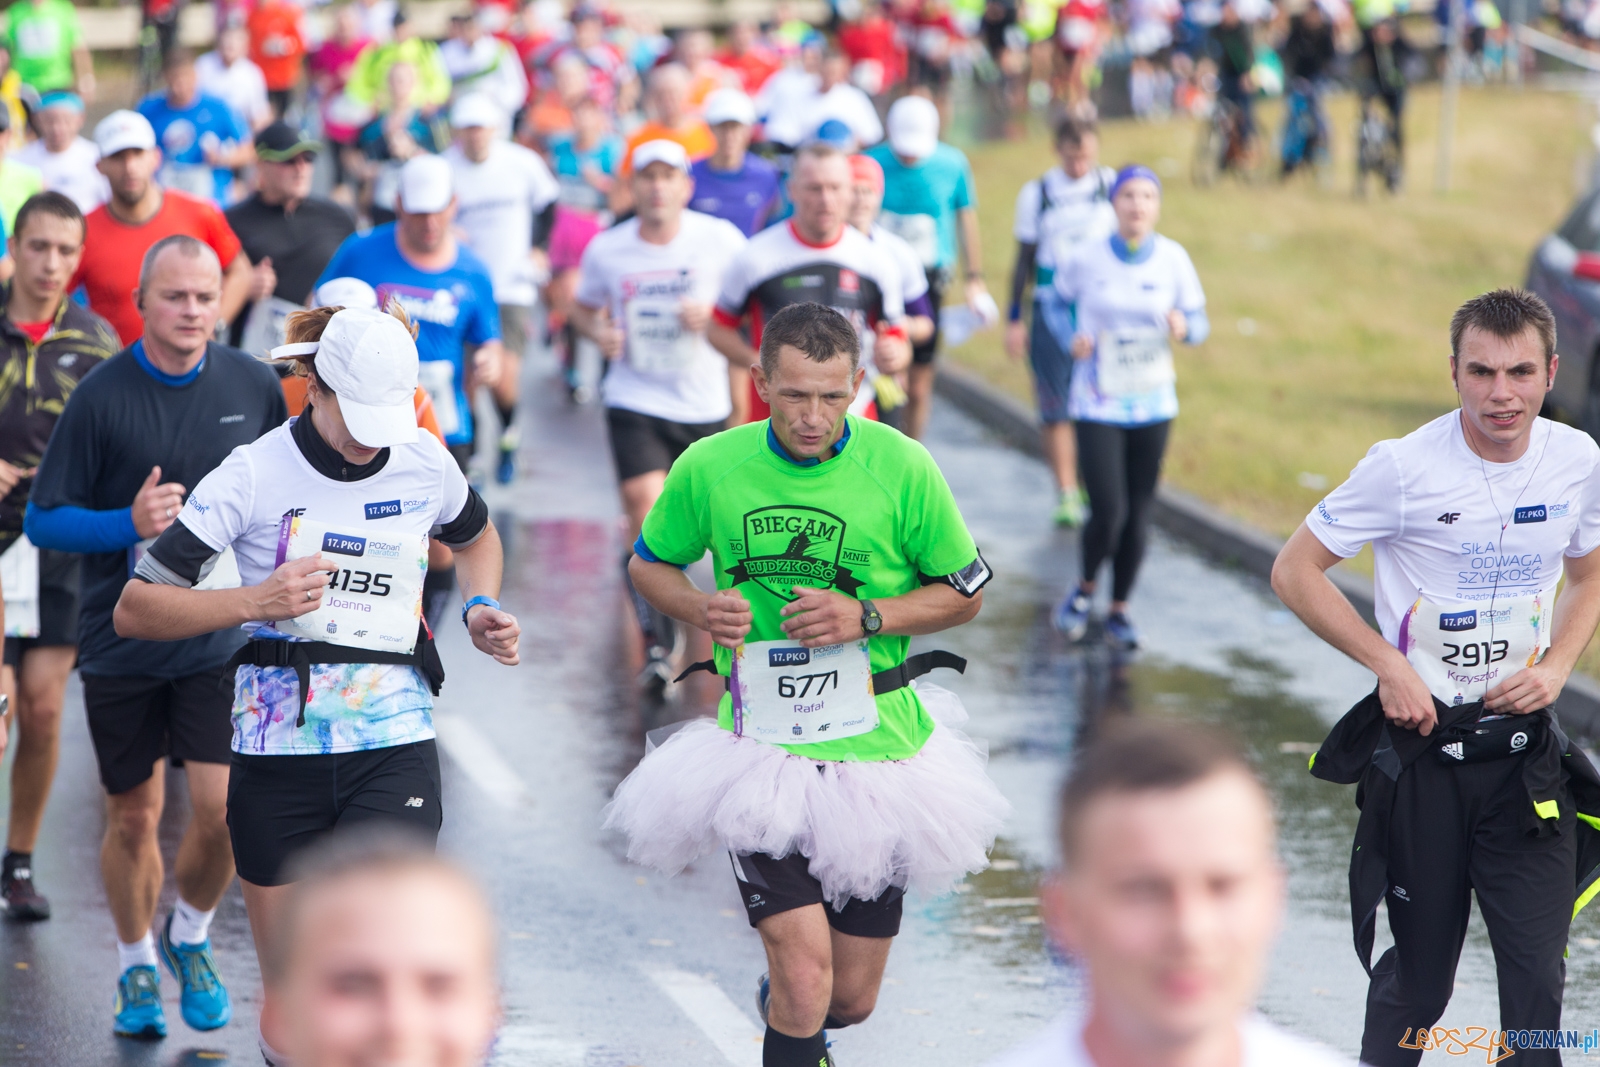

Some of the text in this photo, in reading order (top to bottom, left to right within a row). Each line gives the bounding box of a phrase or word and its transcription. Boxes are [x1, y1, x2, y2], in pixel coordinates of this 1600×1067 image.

[1437, 512, 1461, 525] 4F
[750, 515, 838, 541] BIEGAM
[367, 549, 400, 558] maraton
[730, 542, 744, 552] BO
[1461, 541, 1496, 556] SIŁA
[842, 551, 871, 563] MNIE
[1471, 554, 1542, 570] ODWAGA
[745, 559, 837, 581] LUDZKOŚĆ
[1458, 566, 1541, 583] SZYBKOŚĆ
[325, 568, 393, 597] 4135
[768, 577, 815, 586] WKURWIA
[326, 596, 372, 613] Joanna
[1480, 615, 1511, 624] maraton
[353, 629, 369, 638] 4F
[813, 648, 844, 659] maraton
[1441, 640, 1509, 667] 2913
[1447, 668, 1499, 685] Krzysztof
[778, 670, 838, 698] 6771
[794, 700, 825, 713] Rafał
[817, 723, 831, 732] 4F
